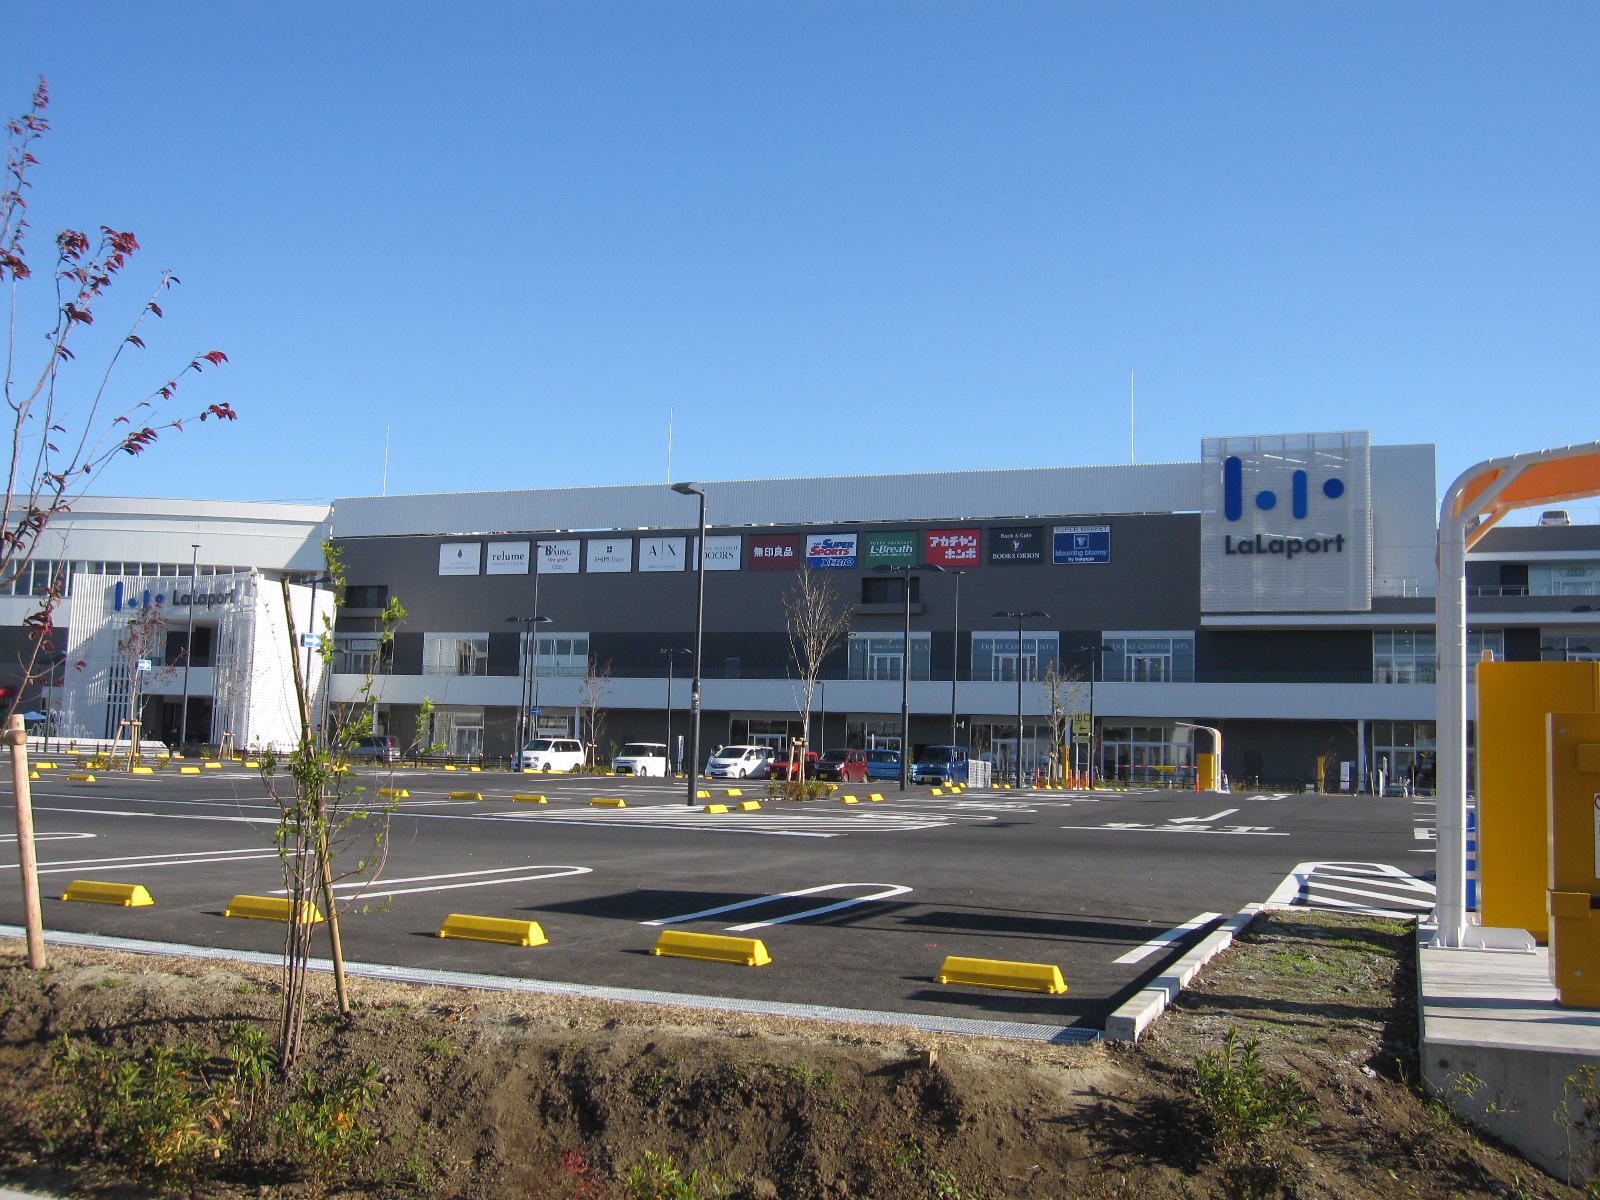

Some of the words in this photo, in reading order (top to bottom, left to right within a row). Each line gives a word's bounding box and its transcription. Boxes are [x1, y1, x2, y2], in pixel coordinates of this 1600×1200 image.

[809, 545, 850, 556] SPORTS
[870, 544, 913, 554] L-Breath
[1225, 534, 1345, 559] LaLaport
[492, 551, 525, 561] relume
[753, 546, 794, 558] 無印良品
[1055, 550, 1083, 558] blooming
